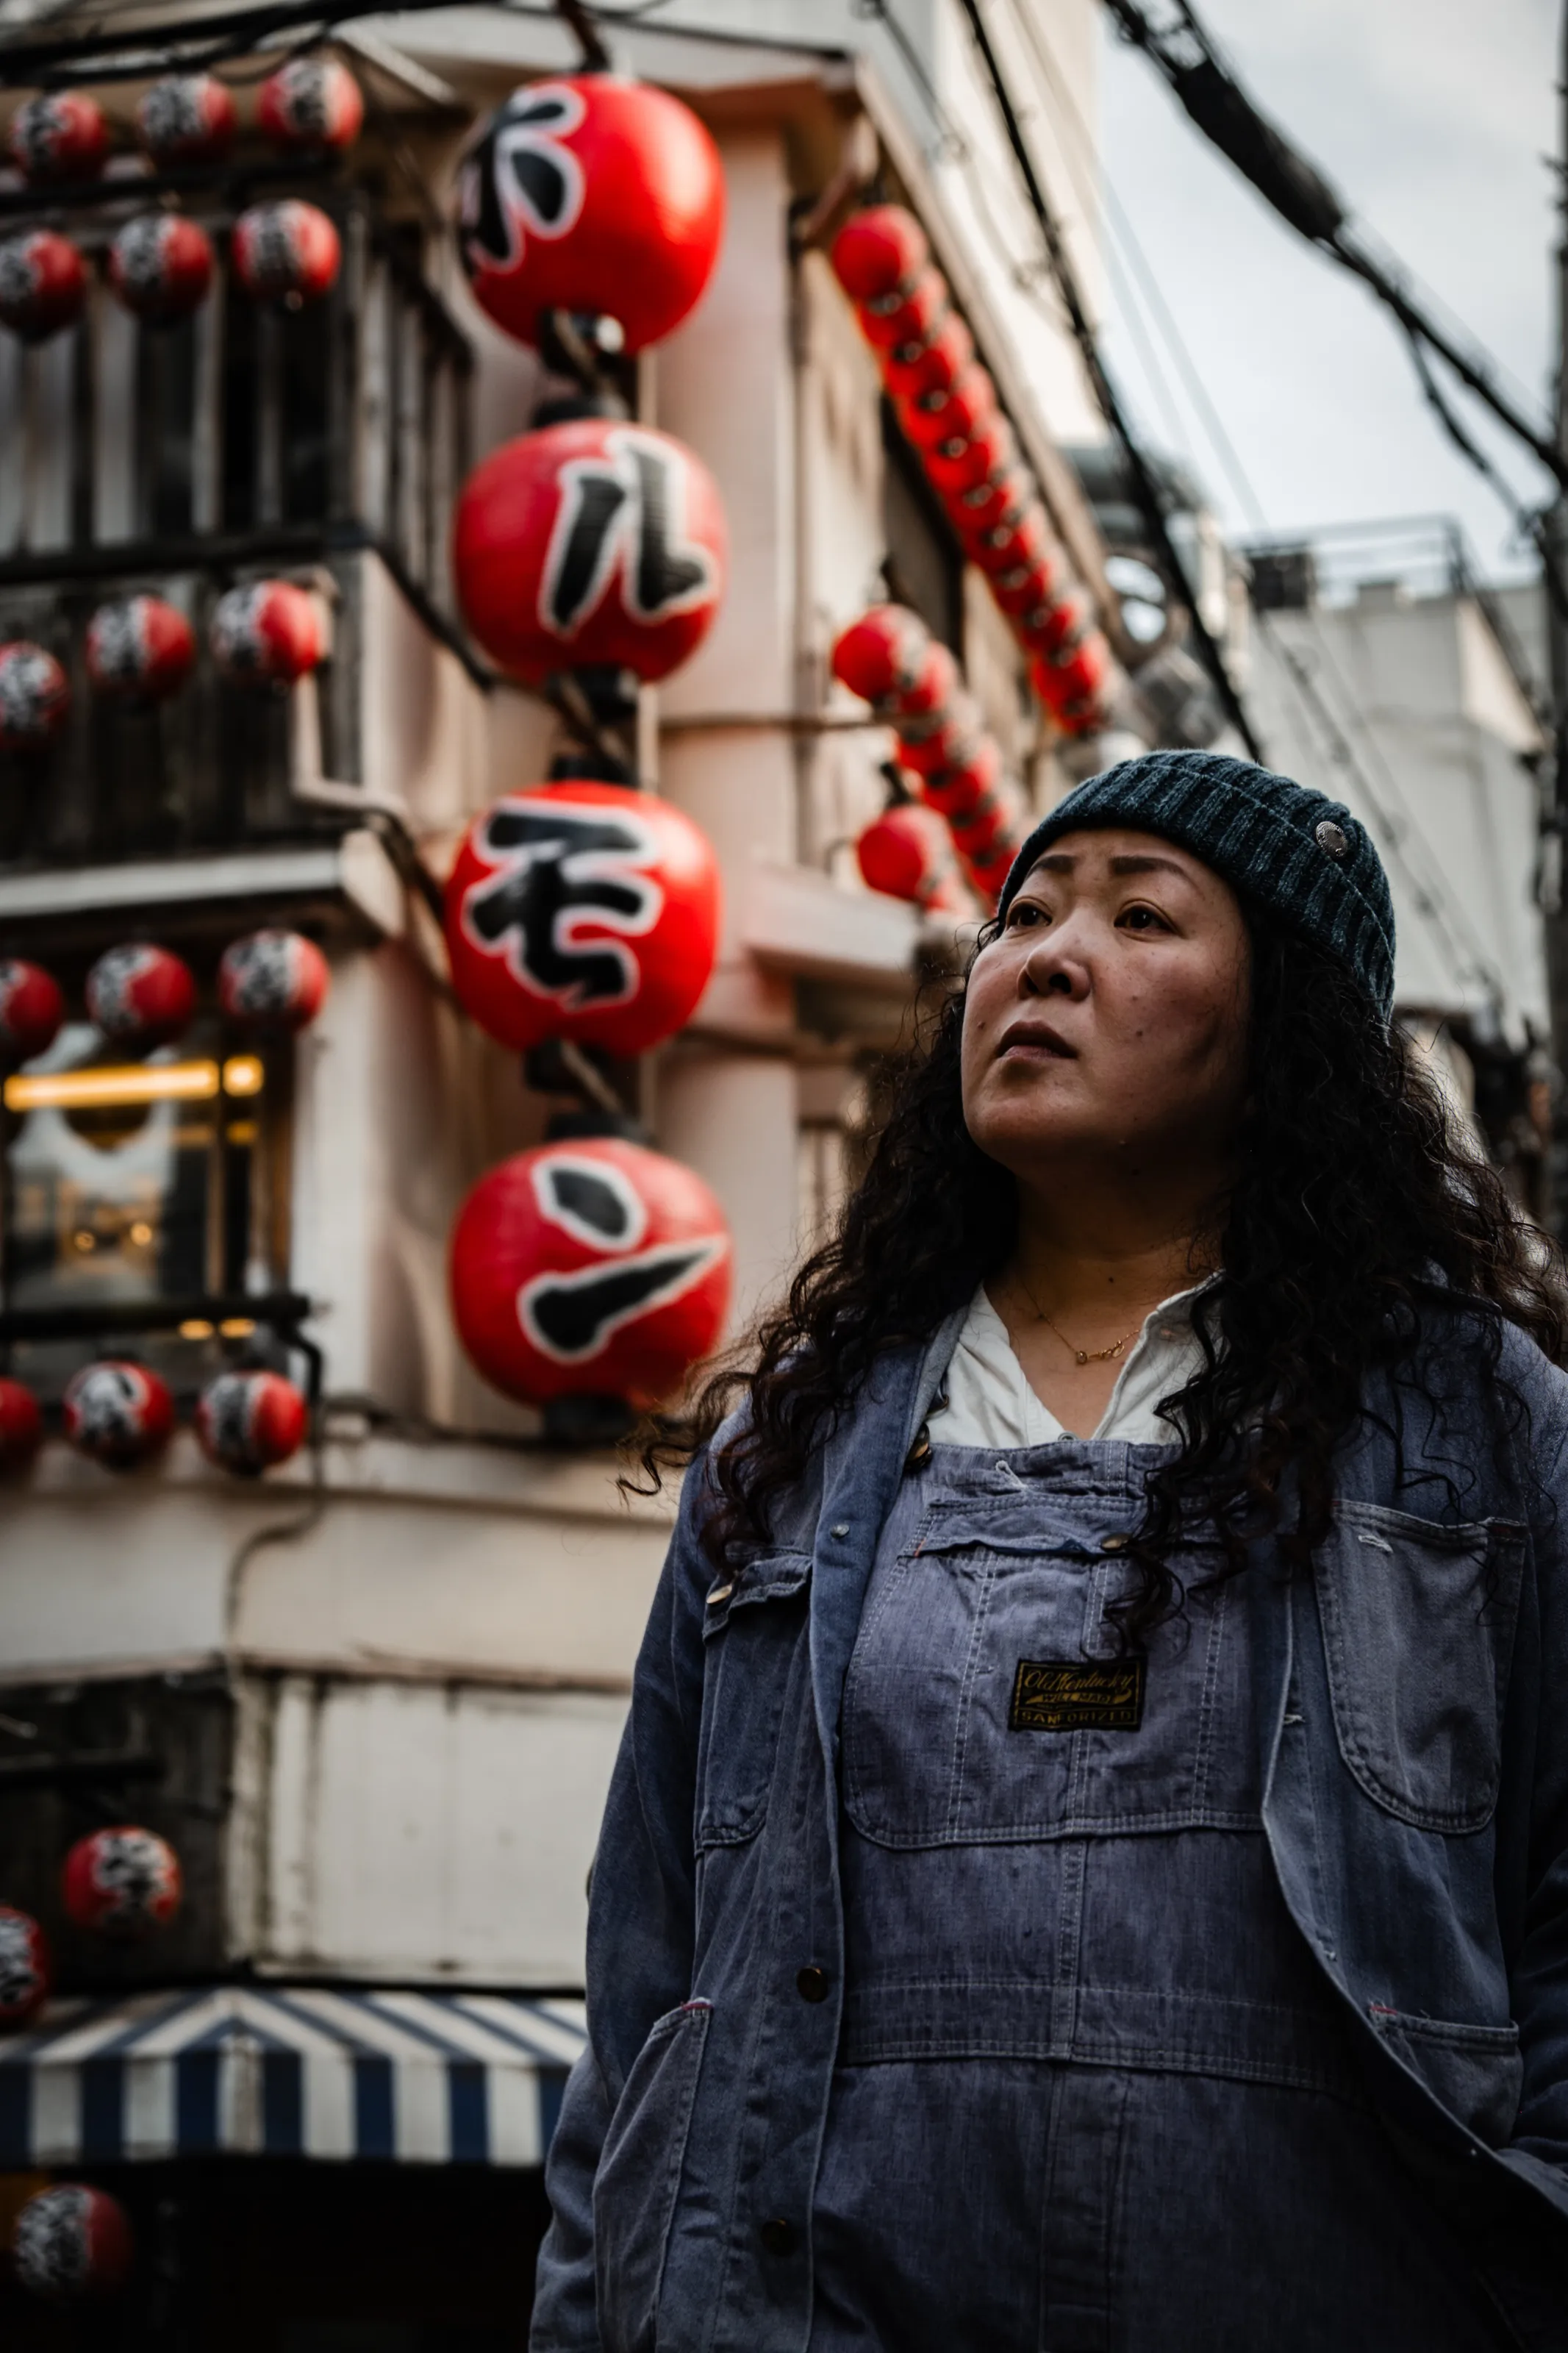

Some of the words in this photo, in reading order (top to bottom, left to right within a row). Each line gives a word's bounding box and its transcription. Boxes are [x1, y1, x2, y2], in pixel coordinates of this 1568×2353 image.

[1024, 1669, 1060, 1690] Old
[1058, 1668, 1135, 1693] Kentucky
[1020, 1710, 1133, 1724] SANFORIZED
